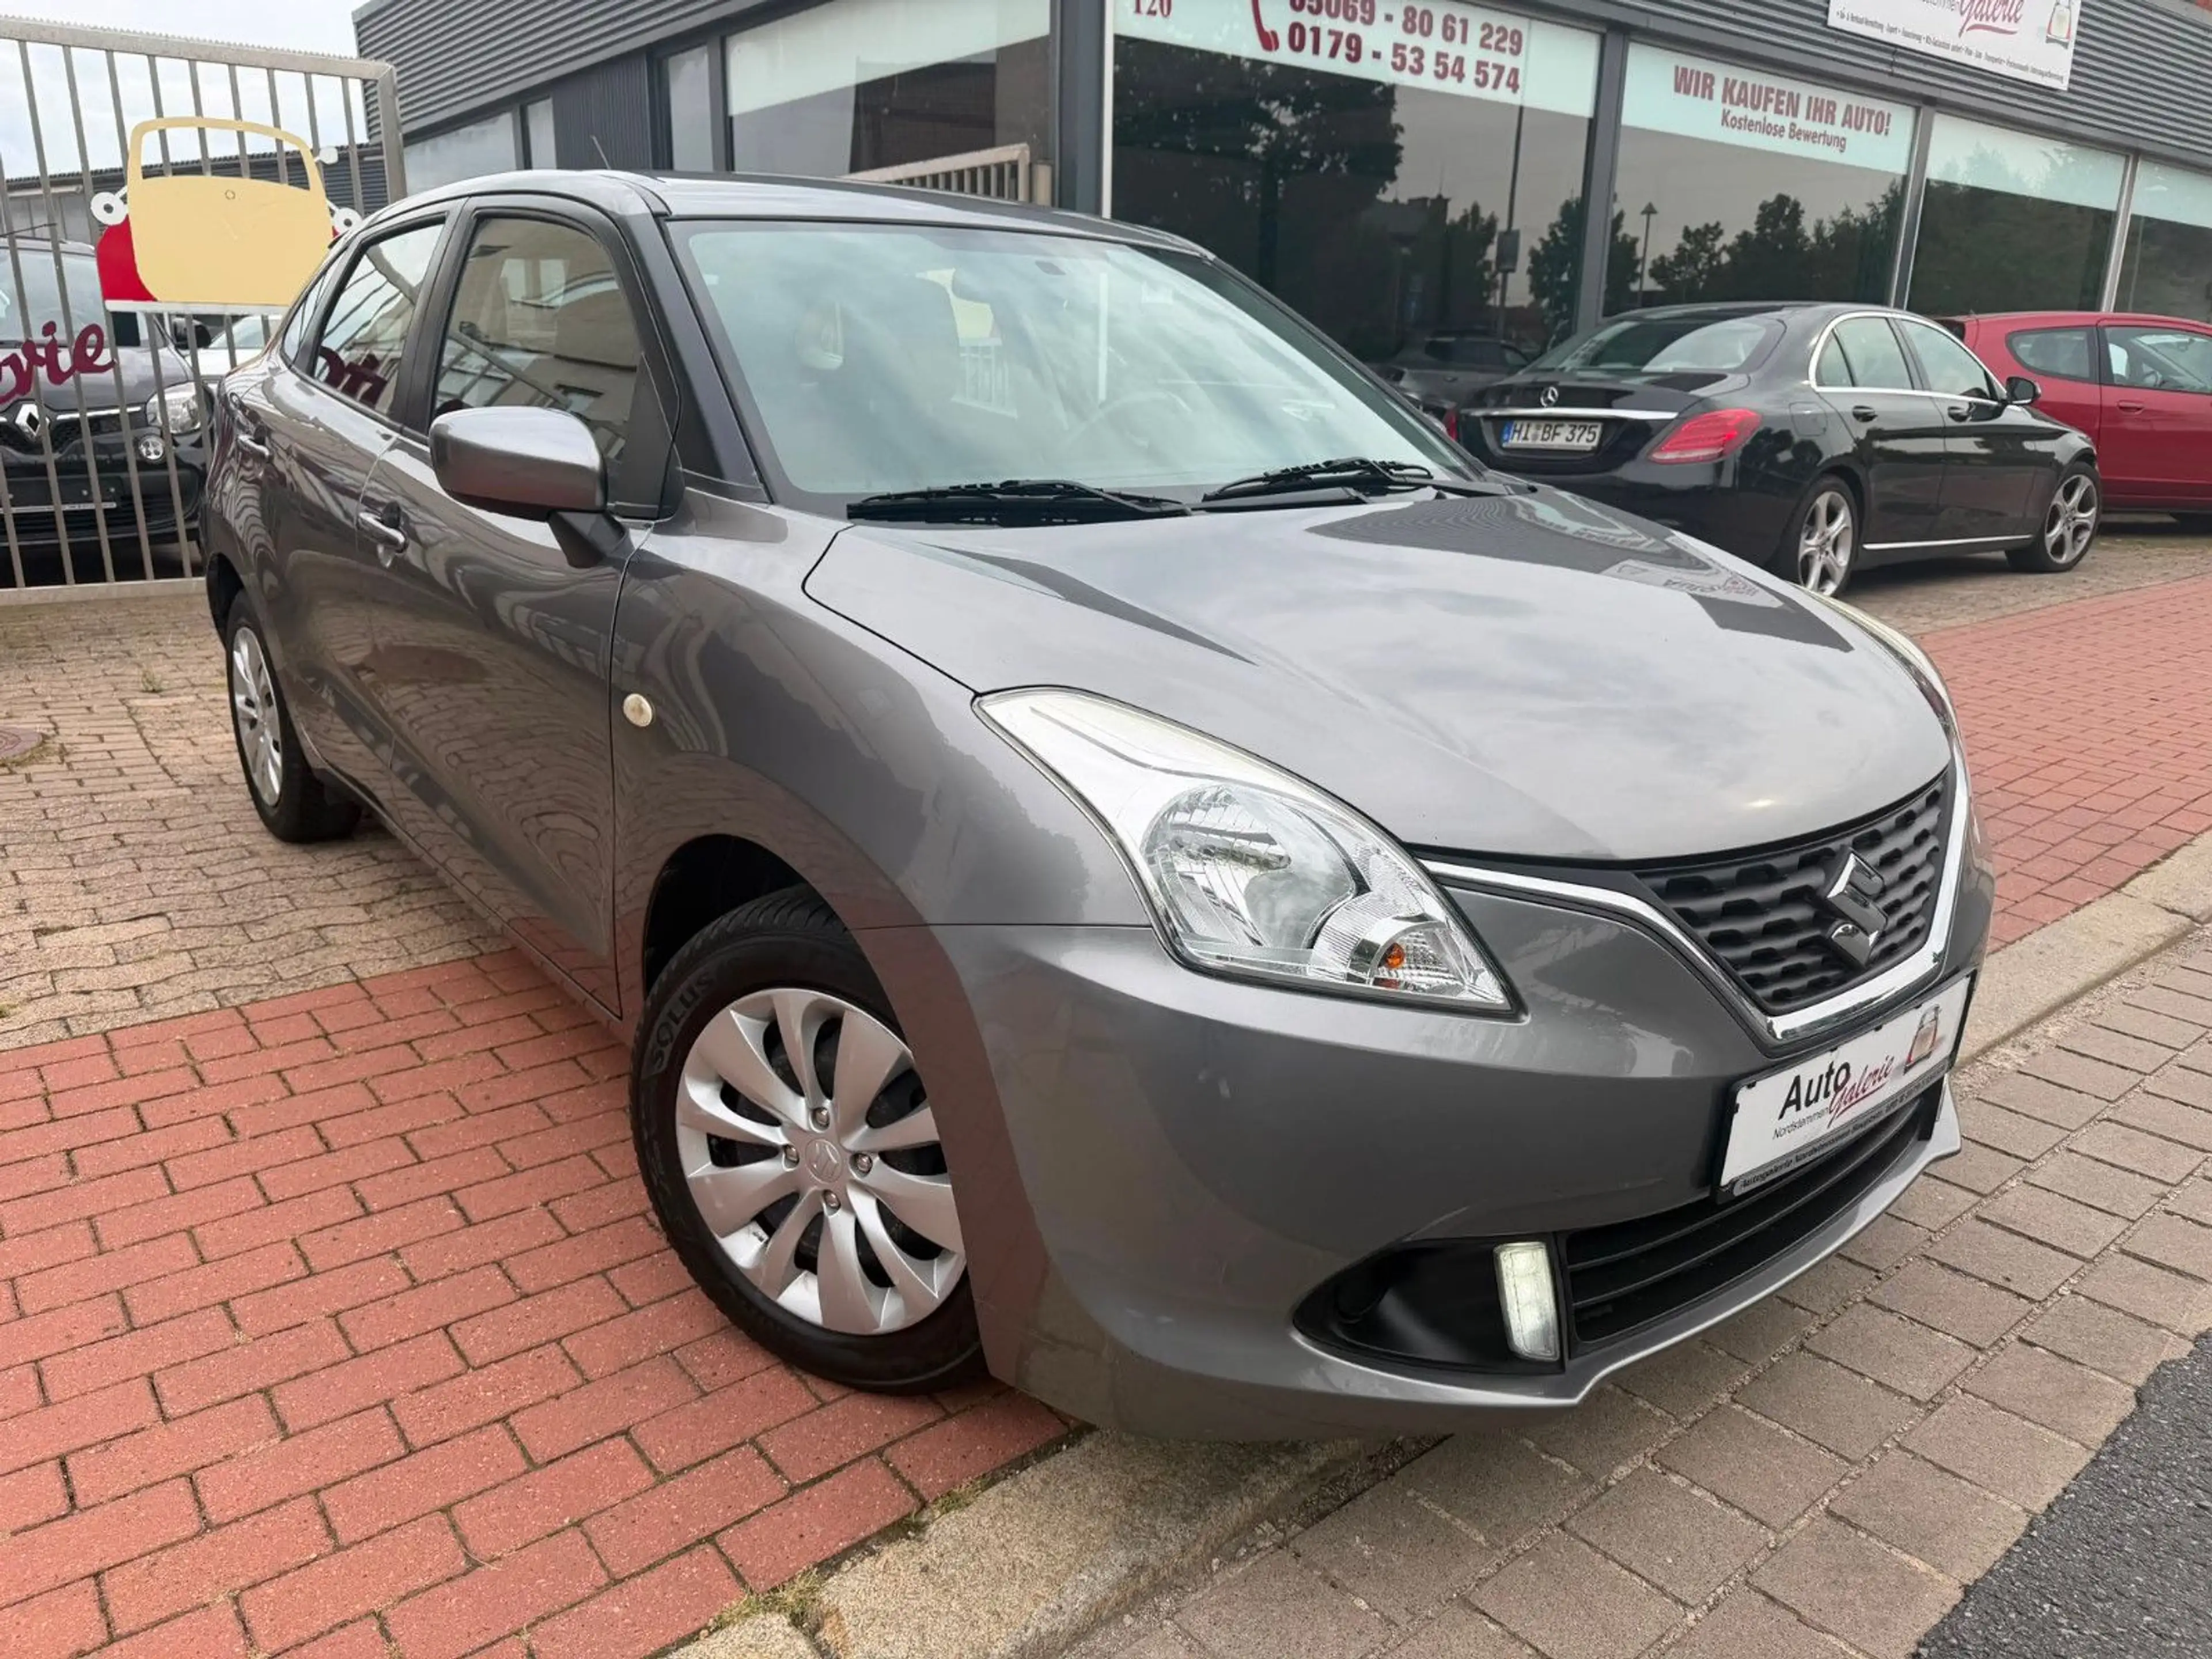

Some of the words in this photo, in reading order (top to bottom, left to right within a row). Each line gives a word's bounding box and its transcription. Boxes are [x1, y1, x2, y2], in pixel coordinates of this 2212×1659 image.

[1288, 21, 1362, 63] 0179
[1391, 43, 1425, 75] 53
[1434, 51, 1465, 84] 54
[1474, 60, 1520, 94] 574
[1402, 5, 1434, 37] 80
[1441, 13, 1469, 44] 61
[1479, 22, 1523, 56] 229
[1674, 65, 1715, 100] WIR
[1721, 77, 1801, 119] KAUFEN
[1805, 96, 1836, 126] IHR
[1841, 104, 1891, 136] AUTO!
[1721, 108, 1786, 138] Kostenlose
[1788, 122, 1847, 153] Bewertung
[1512, 423, 1529, 442] HI
[1540, 424, 1563, 442] BF
[1565, 425, 1599, 444] 375
[652, 971, 713, 1069] SOLUS
[1778, 1060, 1851, 1120] Auto
